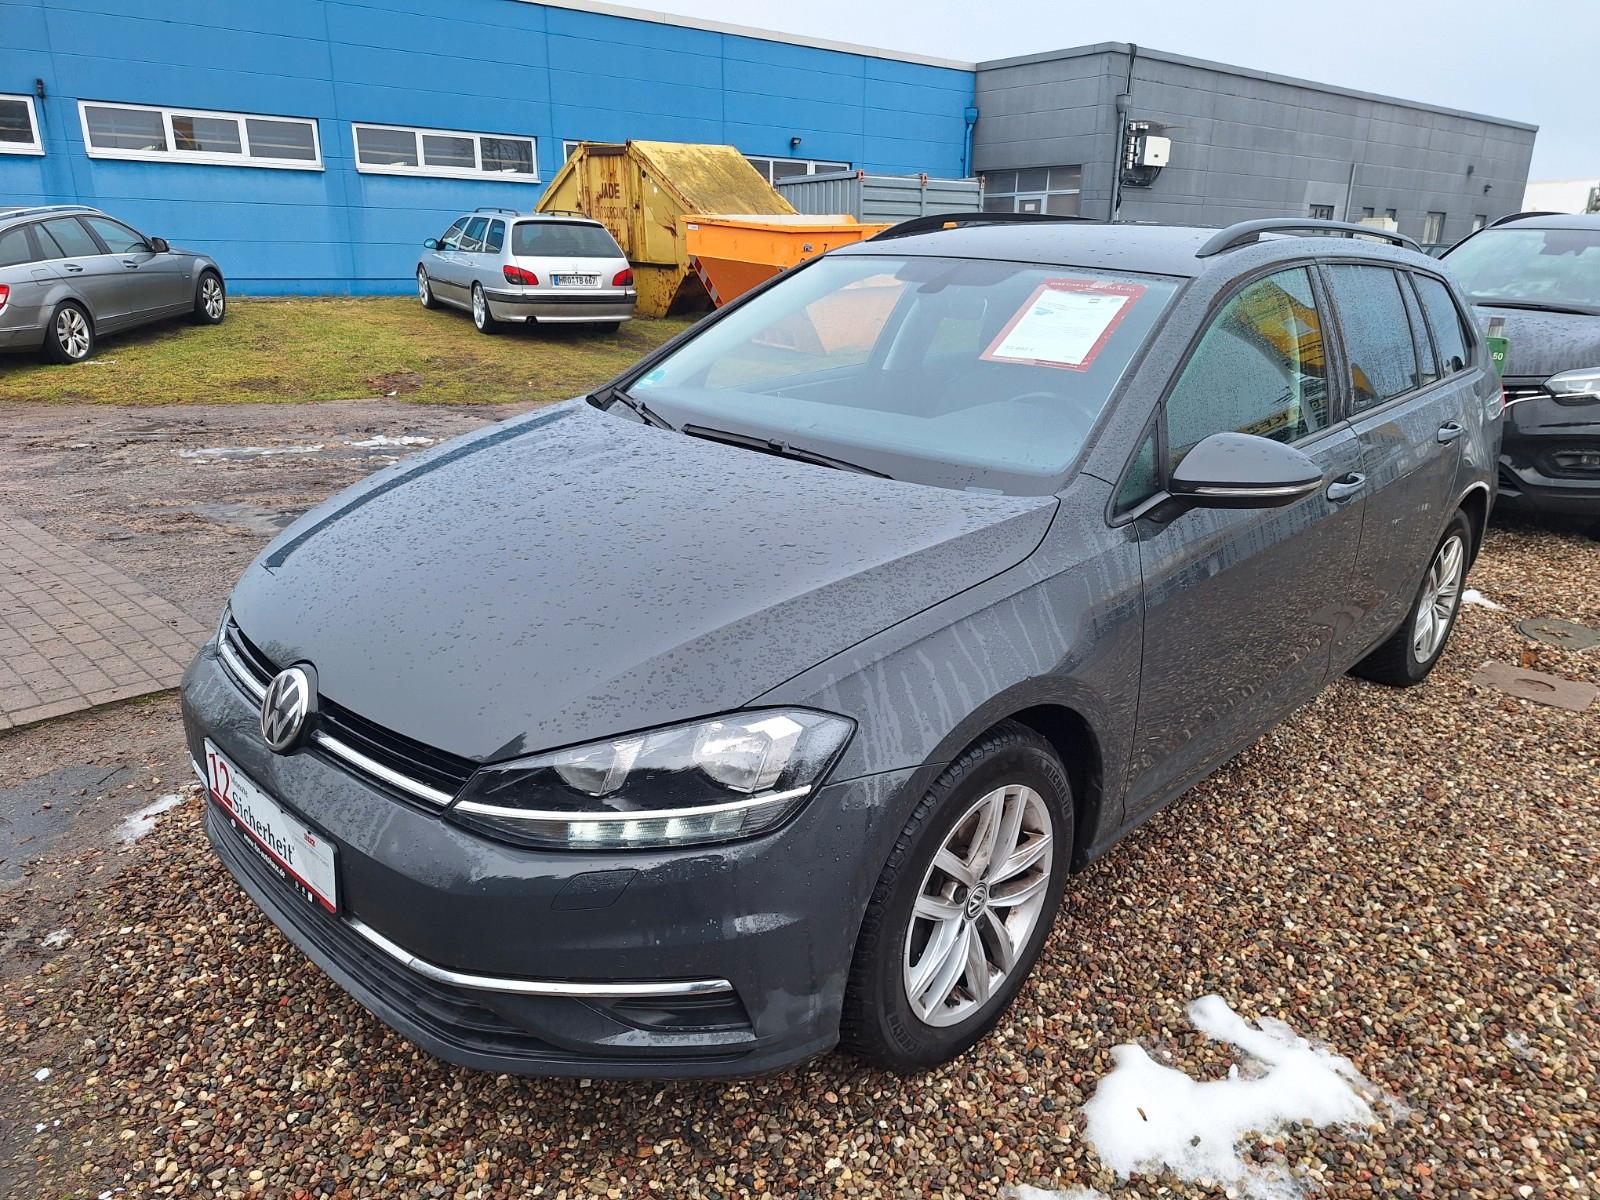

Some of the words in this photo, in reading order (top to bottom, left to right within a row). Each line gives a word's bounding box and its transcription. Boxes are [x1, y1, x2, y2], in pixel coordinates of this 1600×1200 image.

[599, 183, 620, 199] JADE
[584, 276, 596, 285] 667
[208, 753, 233, 808] 12
